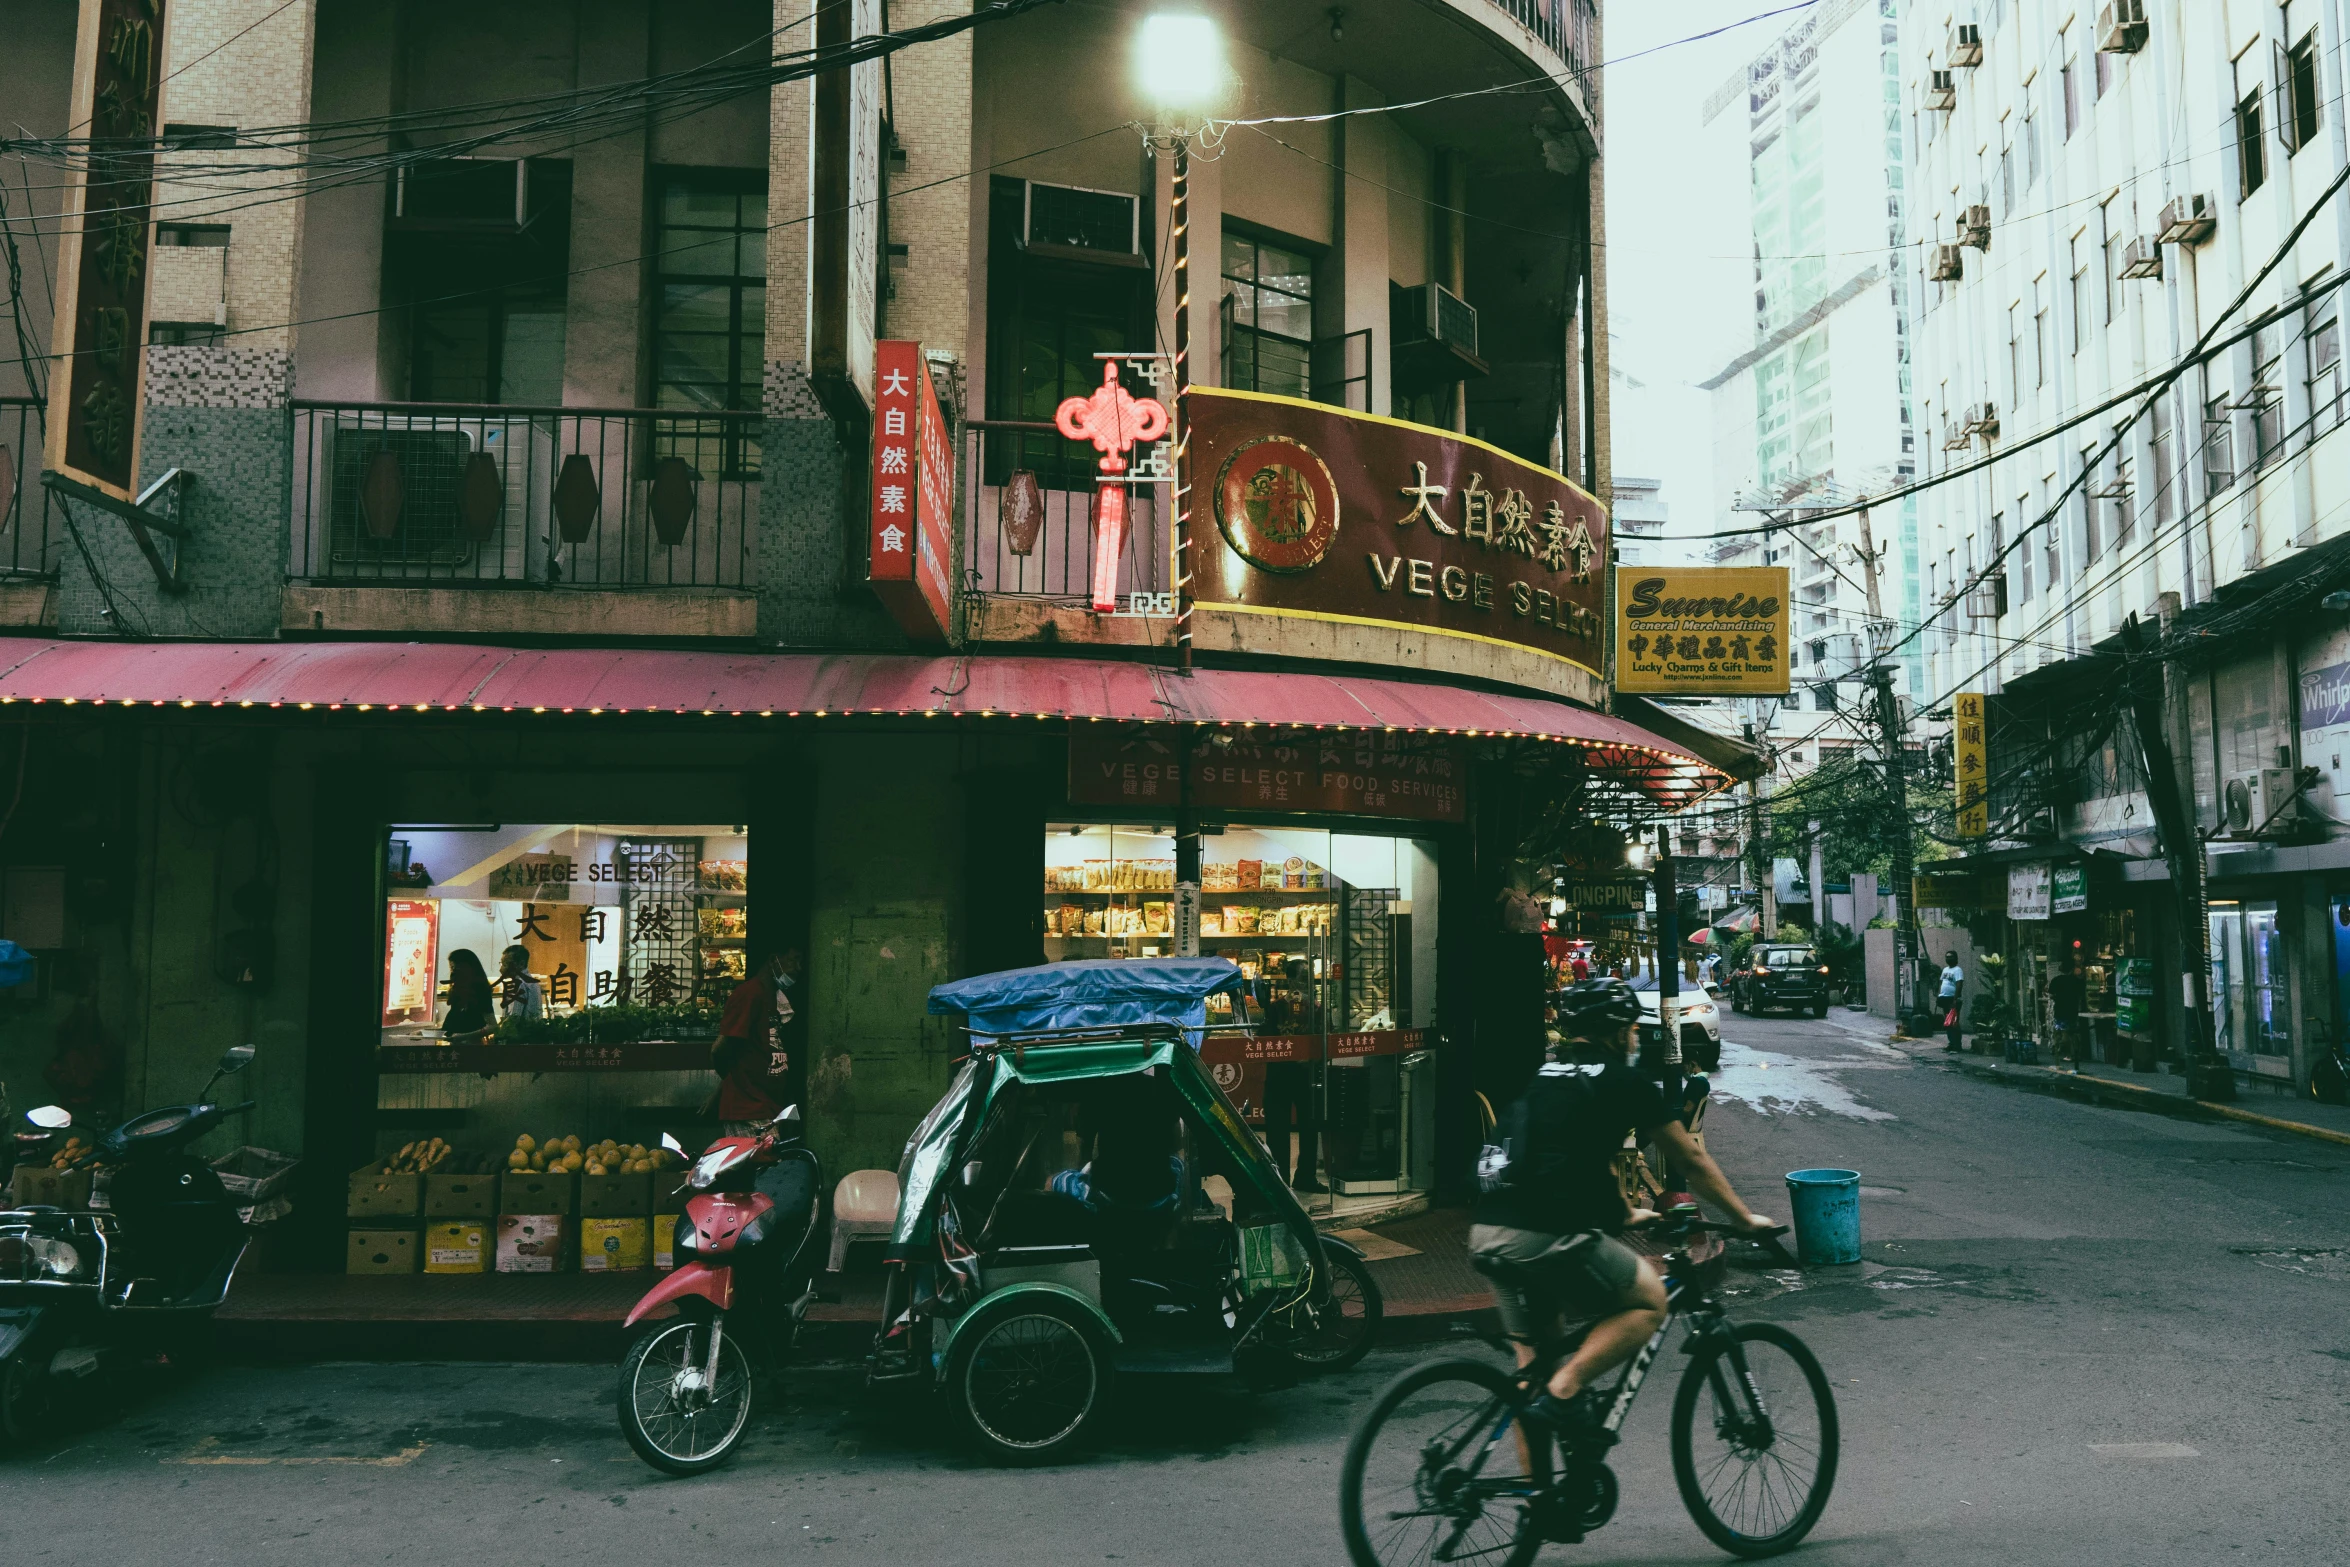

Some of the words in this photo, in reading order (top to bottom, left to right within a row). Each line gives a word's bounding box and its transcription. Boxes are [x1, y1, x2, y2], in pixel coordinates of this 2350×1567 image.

[879, 368, 909, 553] 大自然素食
[1397, 460, 1597, 585] 大自然素食
[1368, 552, 1495, 611] VEGE
[1508, 580, 1602, 645] SELECT
[1626, 577, 1779, 618] Sunrise
[1630, 620, 1679, 632] General
[1682, 620, 1774, 633] Merchandising
[1627, 633, 1778, 661] 中華禮品商業
[1633, 662, 1663, 674] Lucky
[1666, 662, 1705, 674] Charms
[1708, 662, 1718, 673] &
[1721, 662, 1742, 673] Gift
[1745, 662, 1773, 673] Items
[2303, 678, 2350, 712] Whirlp
[1102, 762, 1181, 781] VEGE
[1203, 766, 1305, 787] SELECT
[1323, 772, 1379, 793] FOOD
[1391, 779, 1458, 802] SERVICES
[1122, 779, 1157, 797] 健康
[1259, 784, 1289, 802] 养生
[1363, 791, 1387, 808] 低碳
[526, 863, 578, 882] VEGE
[588, 863, 664, 882] SELECT
[1256, 896, 1284, 904] ONGPIN
[1572, 885, 1632, 906] ONGPIN
[1633, 890, 1645, 900] ST.
[513, 902, 676, 945] 大自然
[441, 962, 735, 1010] 食自助餐厅
[1245, 1039, 1294, 1051] 大自然素食
[1338, 1035, 1377, 1047] 大自然素食
[393, 1049, 461, 1062] 大自然素食
[556, 1047, 623, 1059] 大自然素食
[393, 1062, 418, 1070] VEGE
[422, 1061, 460, 1069] SELECT
[556, 1059, 581, 1067] VEGE
[585, 1059, 622, 1067] SELECT
